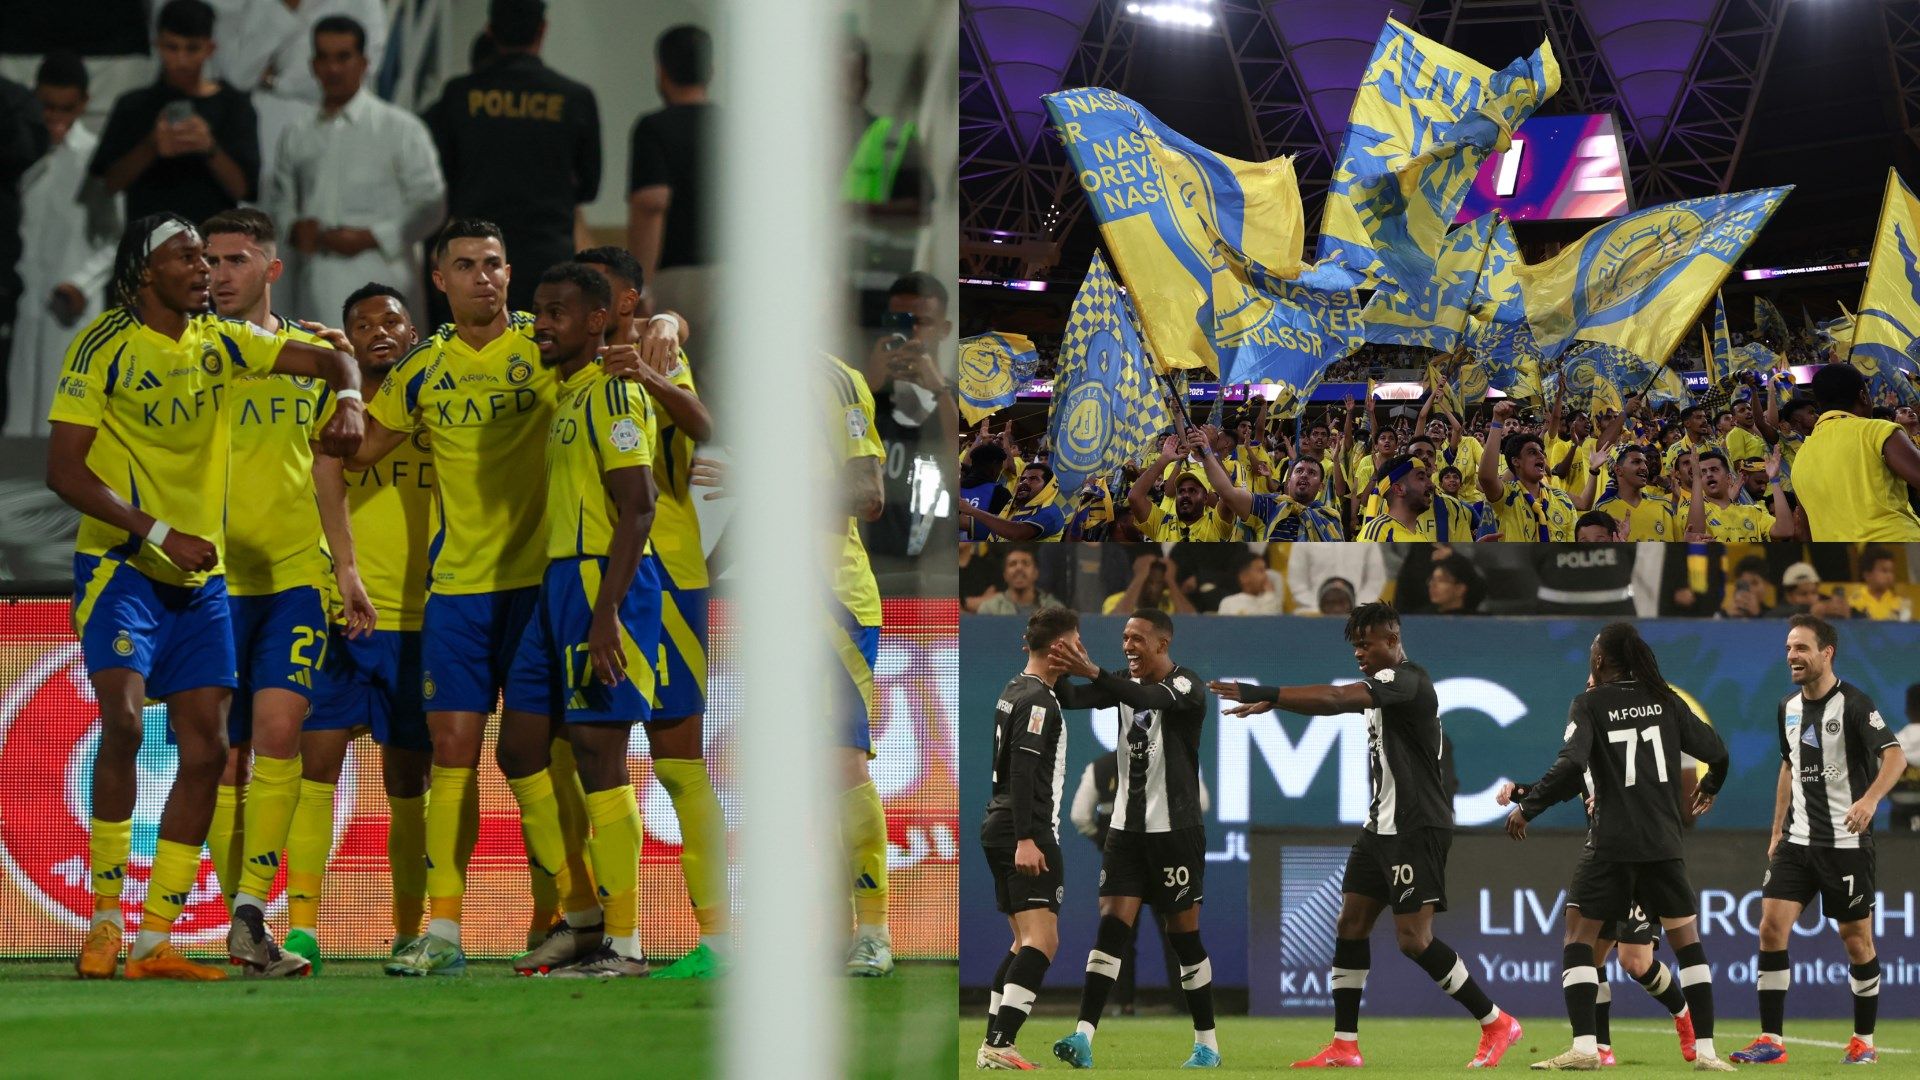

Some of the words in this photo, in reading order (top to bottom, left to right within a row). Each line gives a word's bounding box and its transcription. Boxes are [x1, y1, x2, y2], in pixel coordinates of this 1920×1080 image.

[468, 88, 565, 121] POLICE
[122, 354, 137, 389] Gathern
[240, 397, 311, 425] AFD
[436, 388, 537, 426] KAFD
[344, 461, 433, 489] AFD
[1556, 548, 1617, 569] POLICE
[290, 625, 328, 671] 27
[1608, 703, 1663, 722] M.FOUAD
[1607, 725, 1668, 788] 71
[1163, 866, 1190, 888] 30
[1391, 863, 1414, 886] 70
[1842, 874, 1855, 897] 7
[1479, 887, 1568, 935] LIV
[1478, 953, 1555, 983] Your
[1280, 971, 1366, 994] KA
